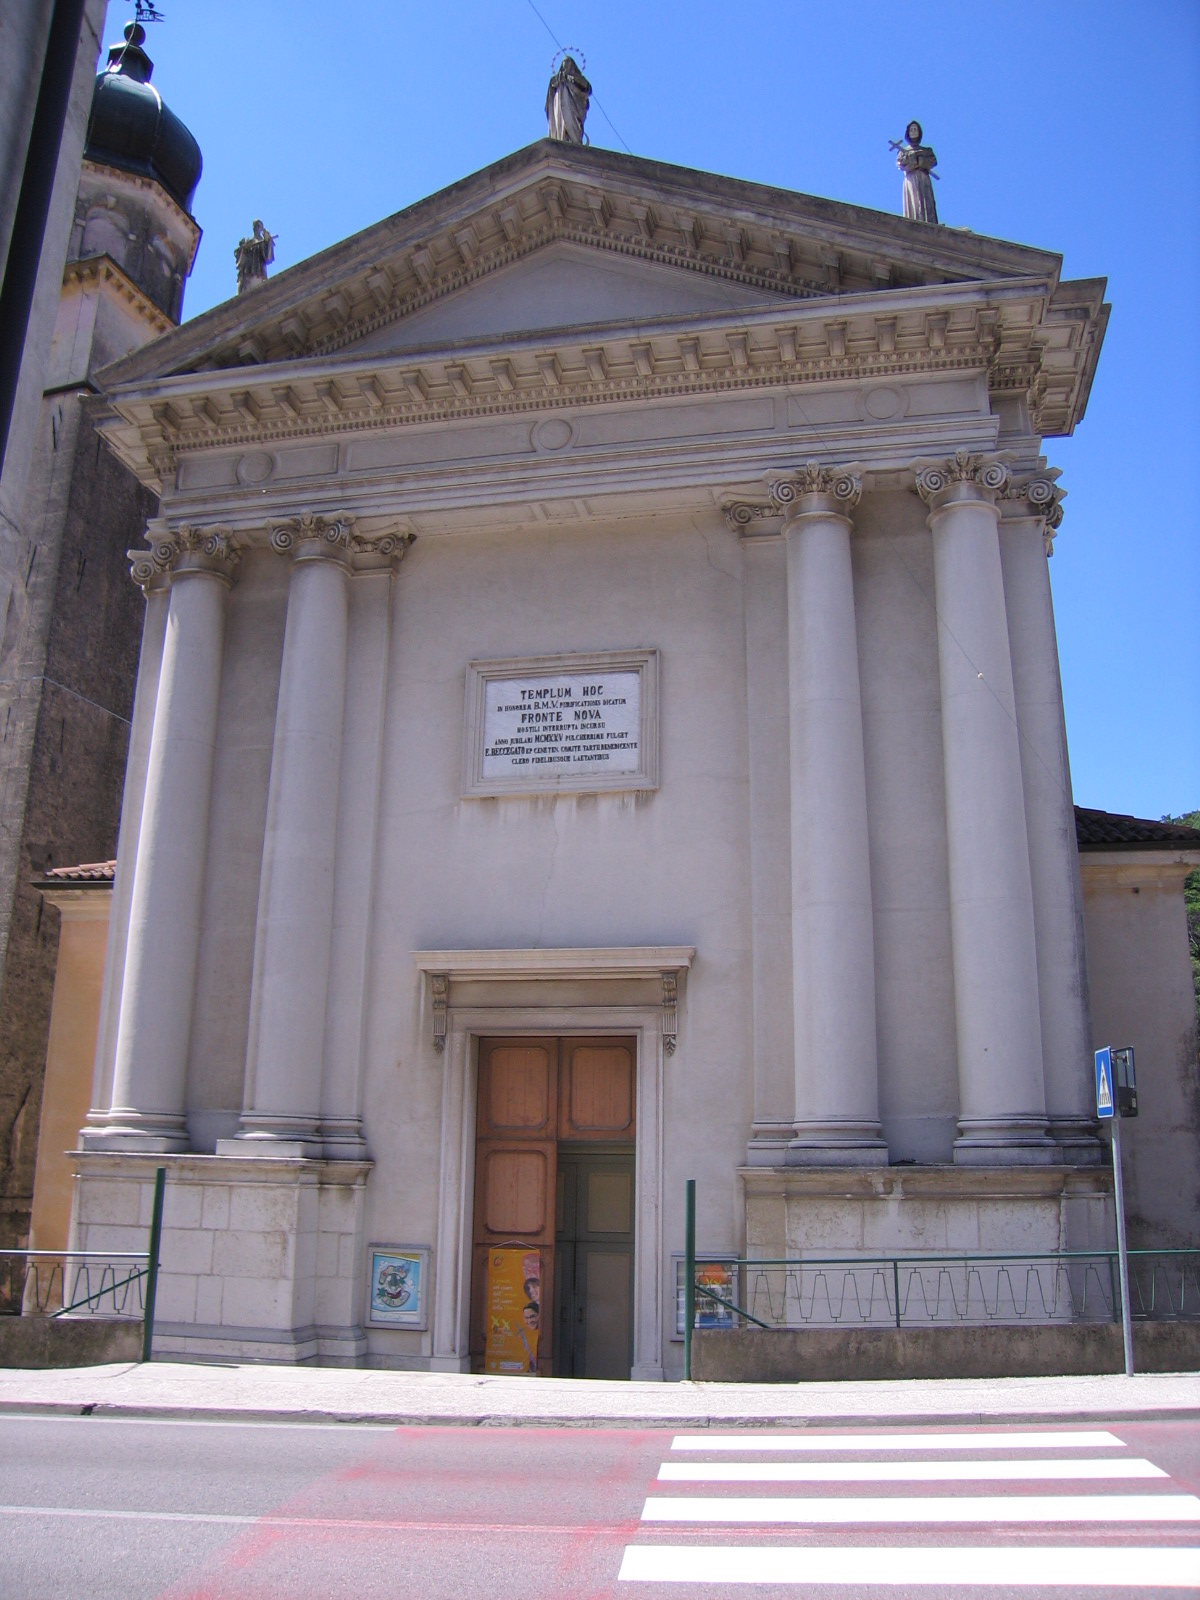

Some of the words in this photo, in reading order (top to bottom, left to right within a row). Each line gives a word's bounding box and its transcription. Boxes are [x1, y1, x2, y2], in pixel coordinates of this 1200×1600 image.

[521, 687, 572, 700] TEMPLUM
[583, 685, 603, 696] HOC
[521, 712, 563, 723] FRONTE
[574, 710, 601, 720] NOVA
[535, 734, 563, 743] MCMXXV
